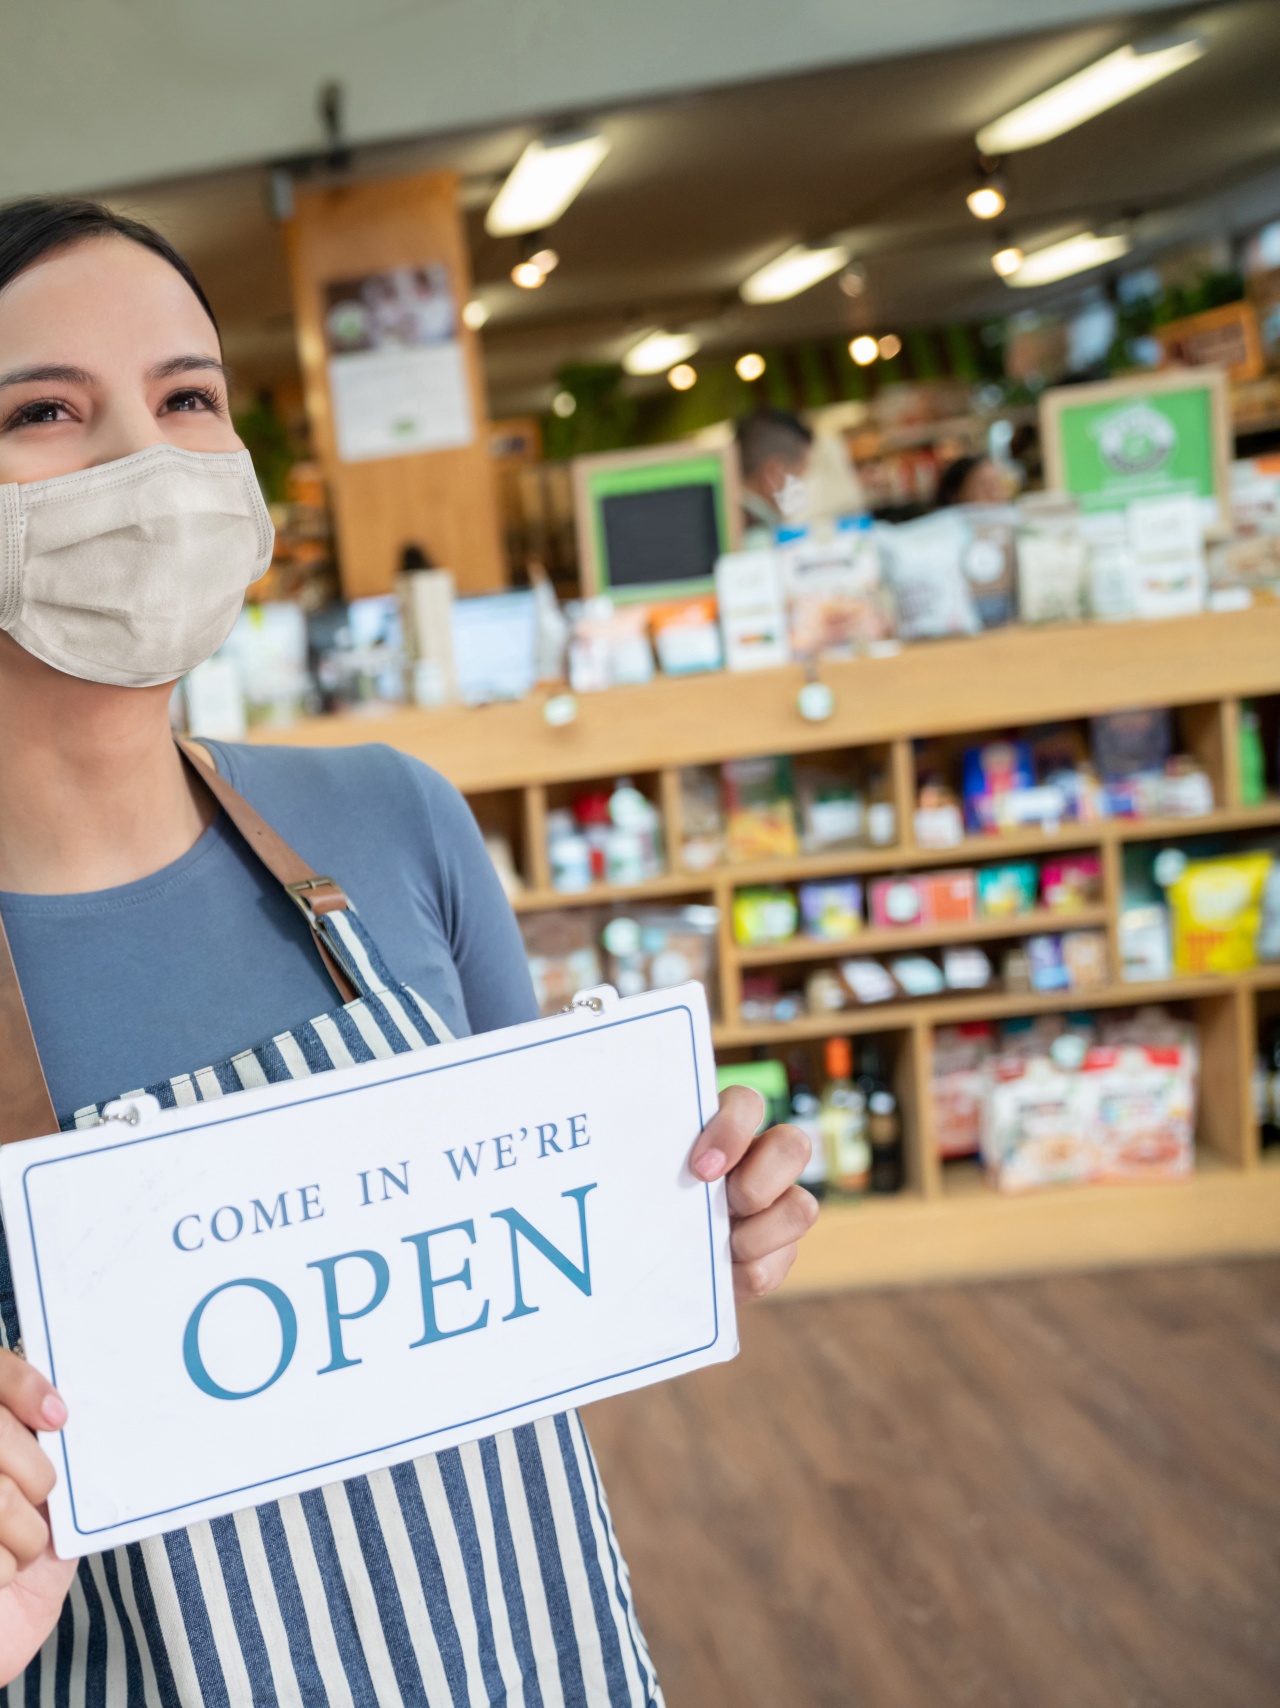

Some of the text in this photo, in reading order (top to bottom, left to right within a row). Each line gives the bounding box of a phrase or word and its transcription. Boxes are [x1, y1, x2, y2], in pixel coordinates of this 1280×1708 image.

[172, 1113, 592, 1252] COME IN WE'RE
[182, 1182, 598, 1401] OPEN
